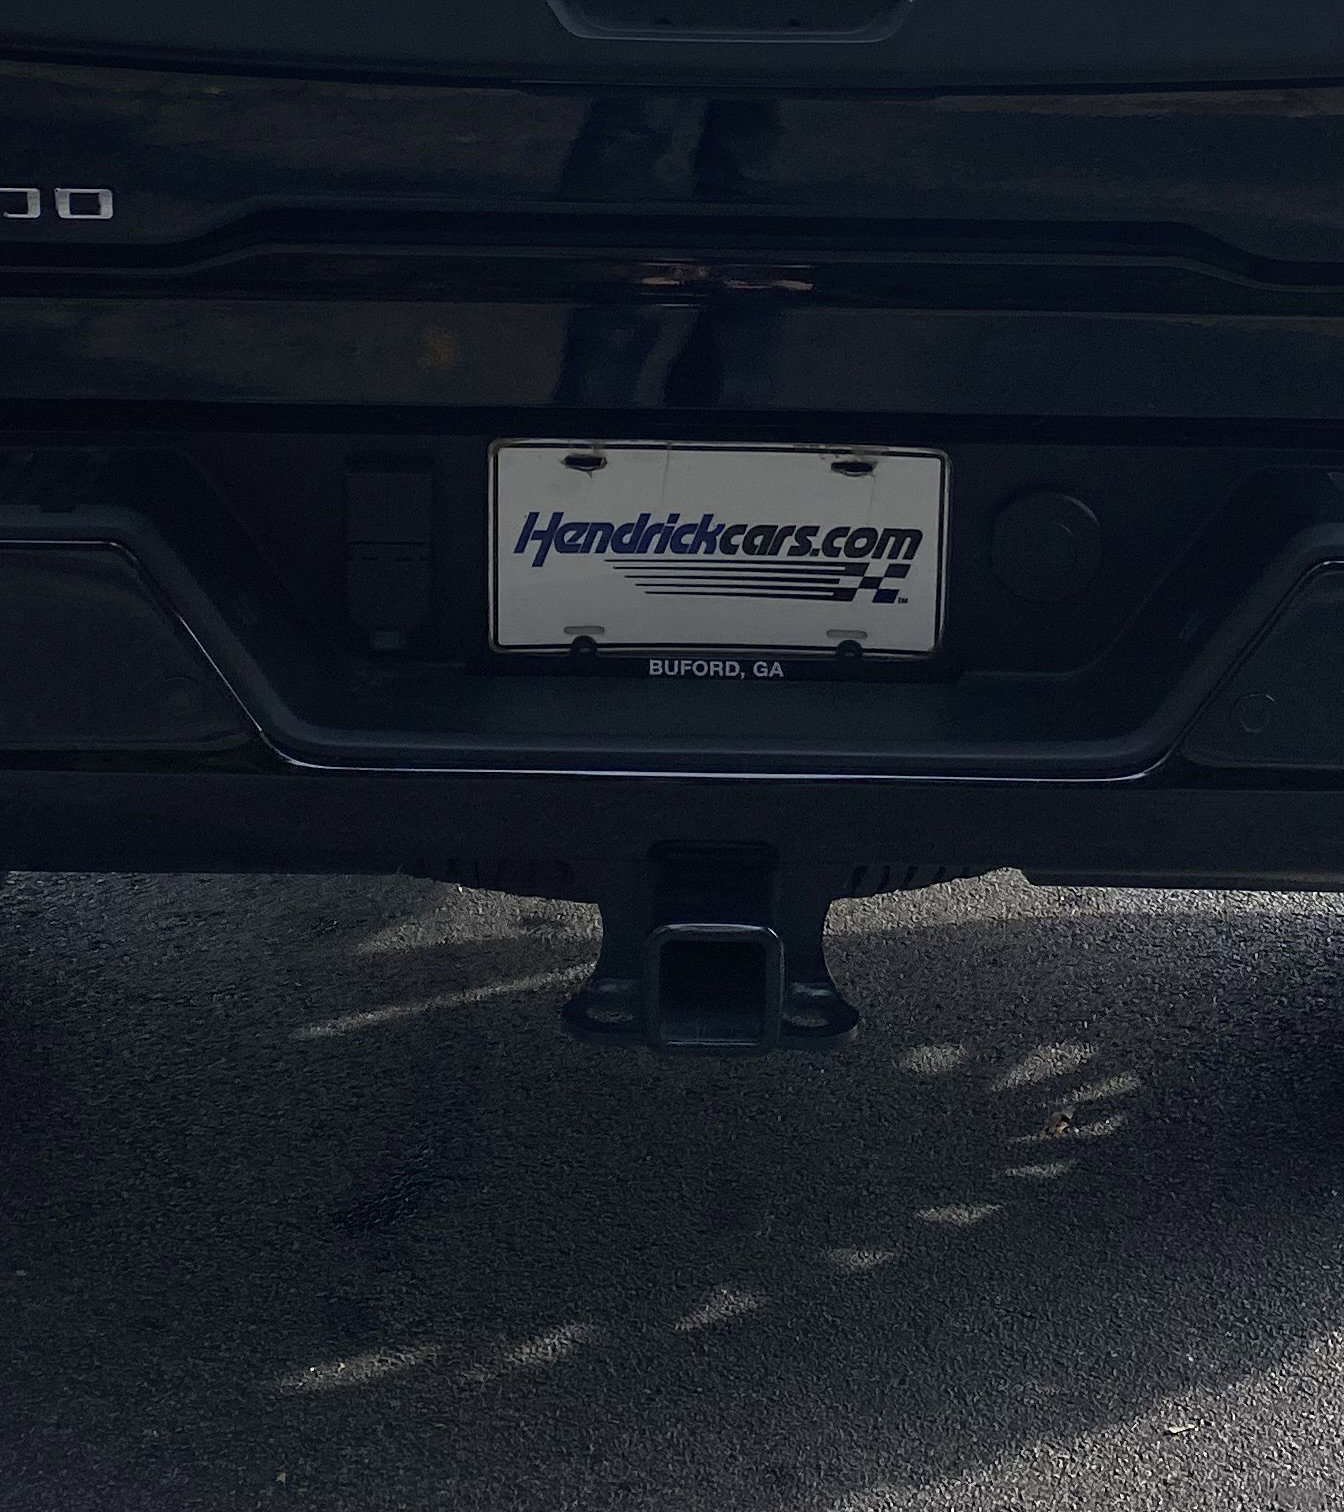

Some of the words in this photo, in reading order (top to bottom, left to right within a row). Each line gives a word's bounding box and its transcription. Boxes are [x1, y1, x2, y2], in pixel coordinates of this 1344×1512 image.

[513, 510, 924, 569] Hendrickcars.com
[648, 658, 746, 680] BUFORD,
[752, 660, 785, 679] GA
